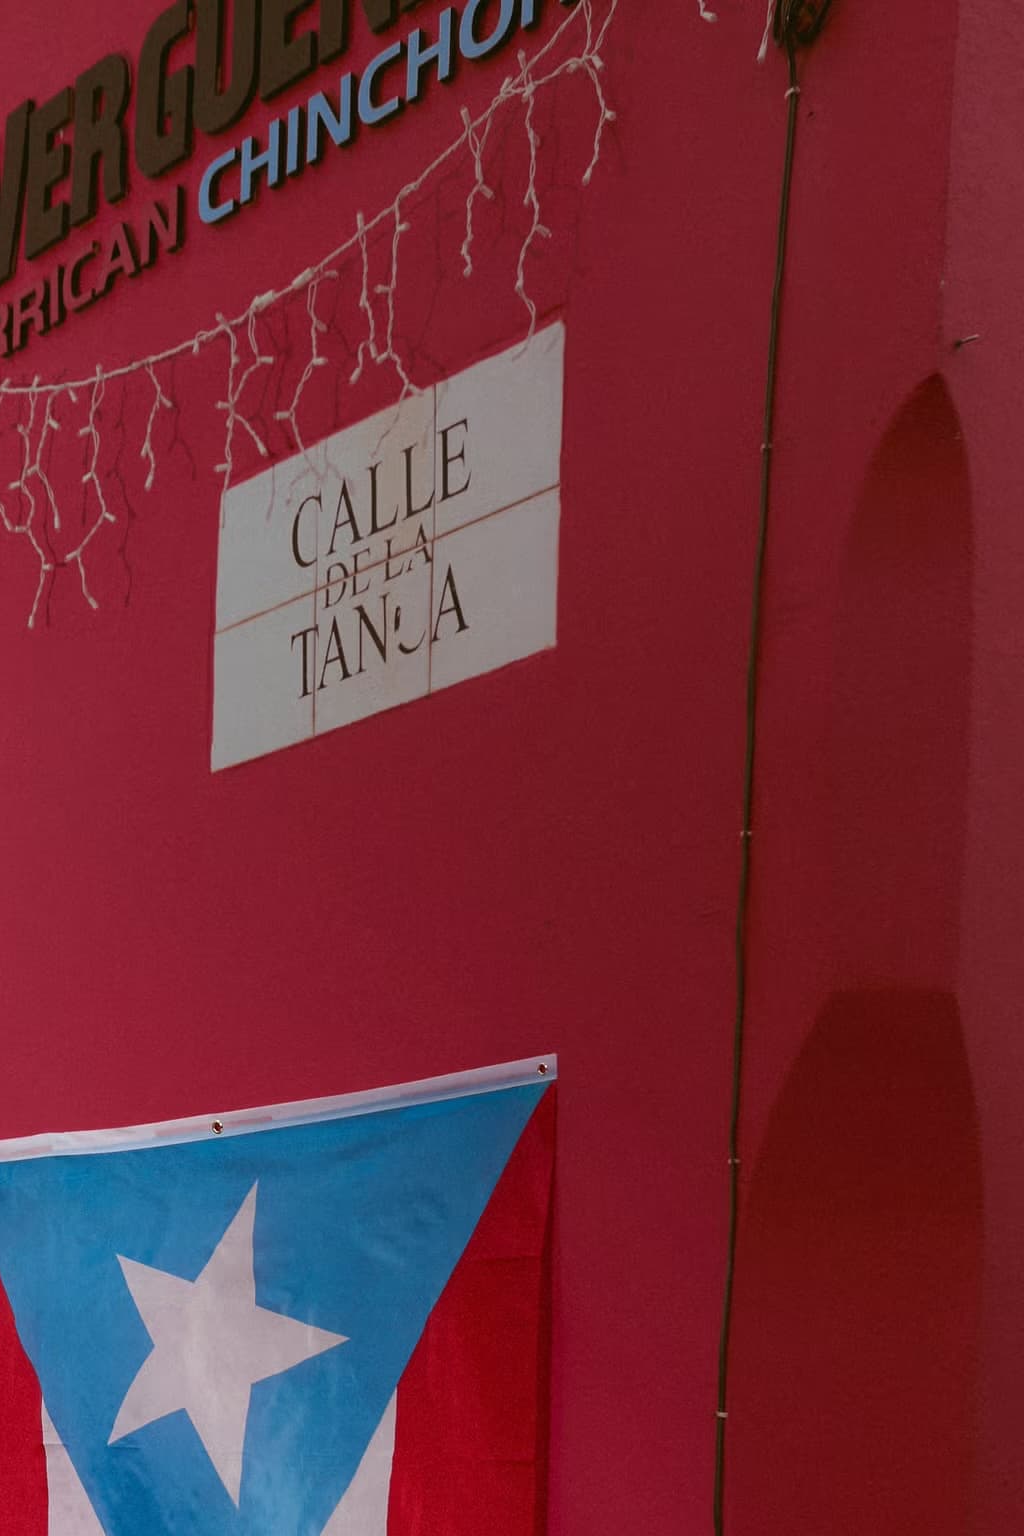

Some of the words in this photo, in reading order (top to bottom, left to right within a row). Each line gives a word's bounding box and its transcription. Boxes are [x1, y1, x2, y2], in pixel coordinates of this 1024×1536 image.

[291, 418, 472, 569] CALLE
[324, 547, 372, 610] DE
[383, 522, 433, 582] LA
